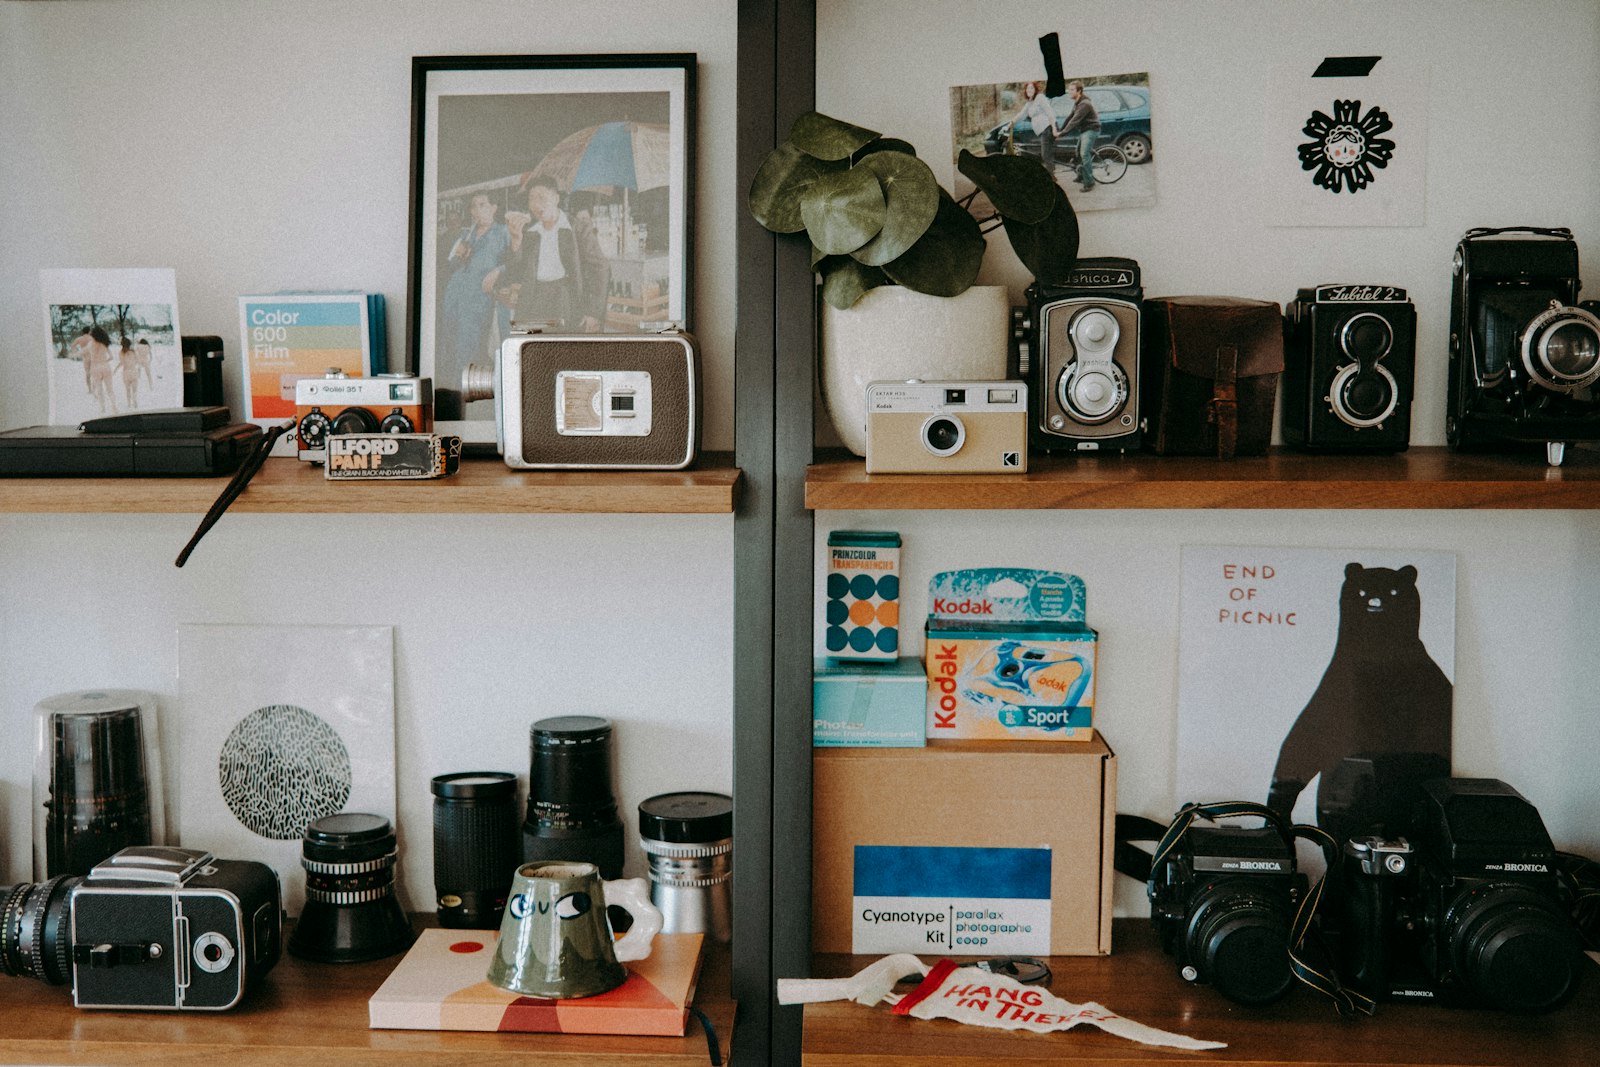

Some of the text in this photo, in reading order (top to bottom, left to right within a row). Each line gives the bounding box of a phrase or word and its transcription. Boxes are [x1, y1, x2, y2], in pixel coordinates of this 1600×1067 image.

[1330, 286, 1395, 301] Lubitel 2
[252, 308, 300, 325] Color
[253, 326, 287, 342] 600
[254, 344, 290, 359] Film
[322, 385, 345, 393] Rollei
[330, 439, 399, 455] ILFORD
[330, 454, 382, 470] PAN F
[832, 549, 877, 560] PRINZCOLOR
[832, 559, 895, 570] TRANSPARENCIES
[1223, 564, 1276, 580] END
[1229, 587, 1257, 601] OF
[933, 598, 993, 615] Kodak
[1218, 608, 1297, 626] PICNIC
[934, 644, 958, 729] Kodak
[1027, 707, 1069, 726] Sport
[1240, 861, 1282, 871] BRONICA
[1503, 863, 1549, 873] BRONICA
[862, 909, 945, 925] Cyanotype
[956, 908, 1004, 920] parallax
[956, 922, 1032, 935] photographic
[926, 930, 945, 943] Kit
[956, 936, 988, 947] coop
[944, 984, 1044, 1007] HANG
[1404, 990, 1434, 998] BRONICA
[956, 998, 990, 1012] IN
